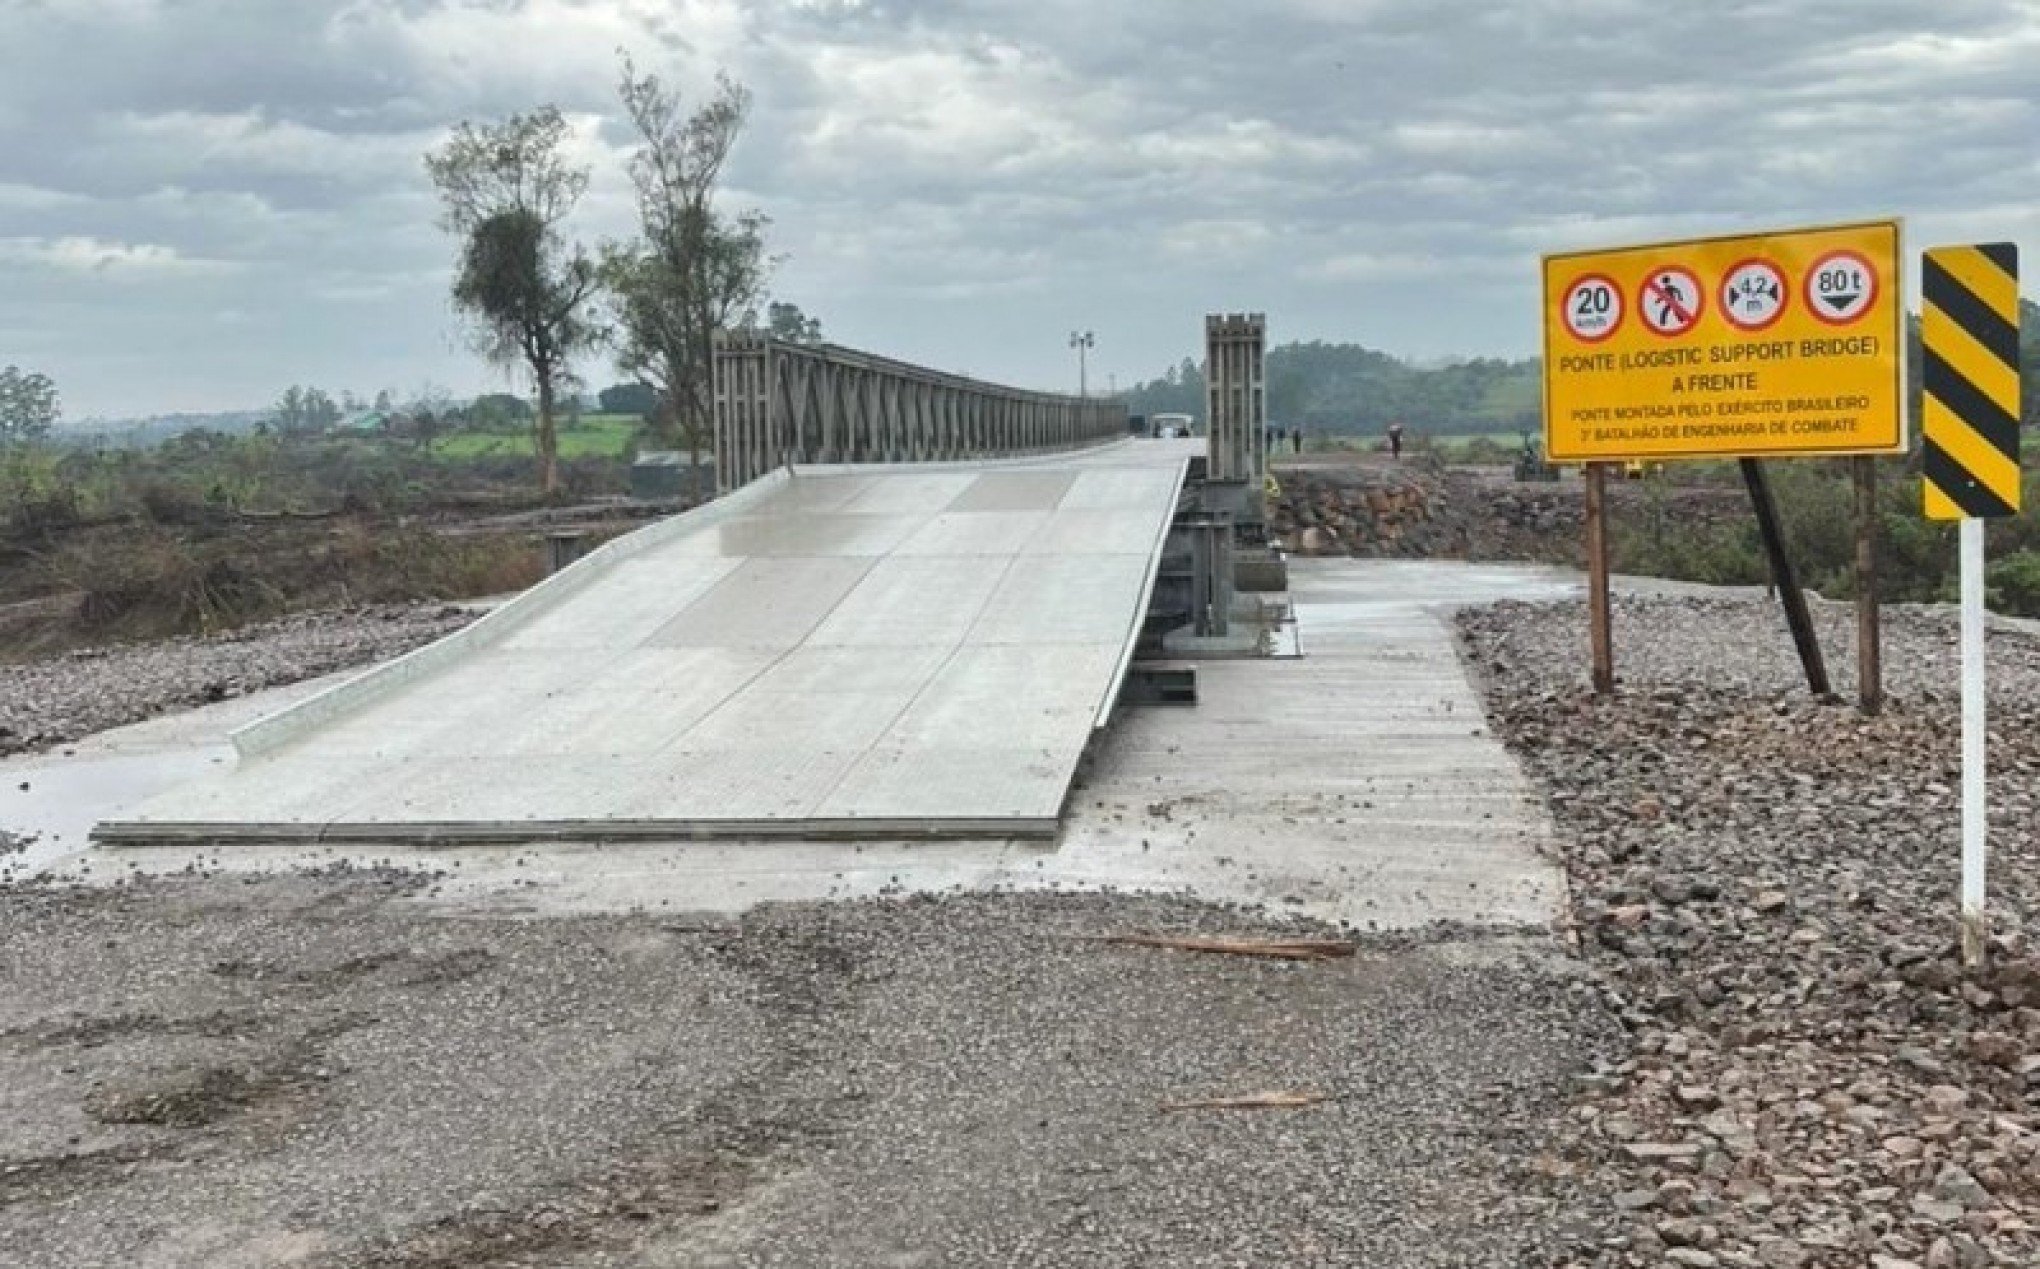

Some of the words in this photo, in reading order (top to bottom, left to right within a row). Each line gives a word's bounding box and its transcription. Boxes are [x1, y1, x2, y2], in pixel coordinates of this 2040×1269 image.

[1819, 269, 1847, 292] 80
[1852, 269, 1861, 290] t
[1577, 286, 1609, 313] 20
[1747, 300, 1762, 311] m
[1560, 353, 1614, 372] PONTE
[1619, 346, 1701, 373] (LOGISTIC
[1710, 340, 1795, 363] SUPPORT
[1801, 335, 1879, 358] BRIDGE)
[1688, 371, 1758, 392] FRENTE
[1571, 407, 1610, 421] PONTE
[1615, 404, 1675, 419] MONTADA
[1678, 402, 1712, 418] PELO
[1787, 395, 1870, 414] BRASILEIRO
[1662, 425, 1679, 439] DE
[1683, 421, 1766, 438] ENGENHARIA
[1770, 420, 1787, 434] DE
[1792, 417, 1857, 434] COMBATE
